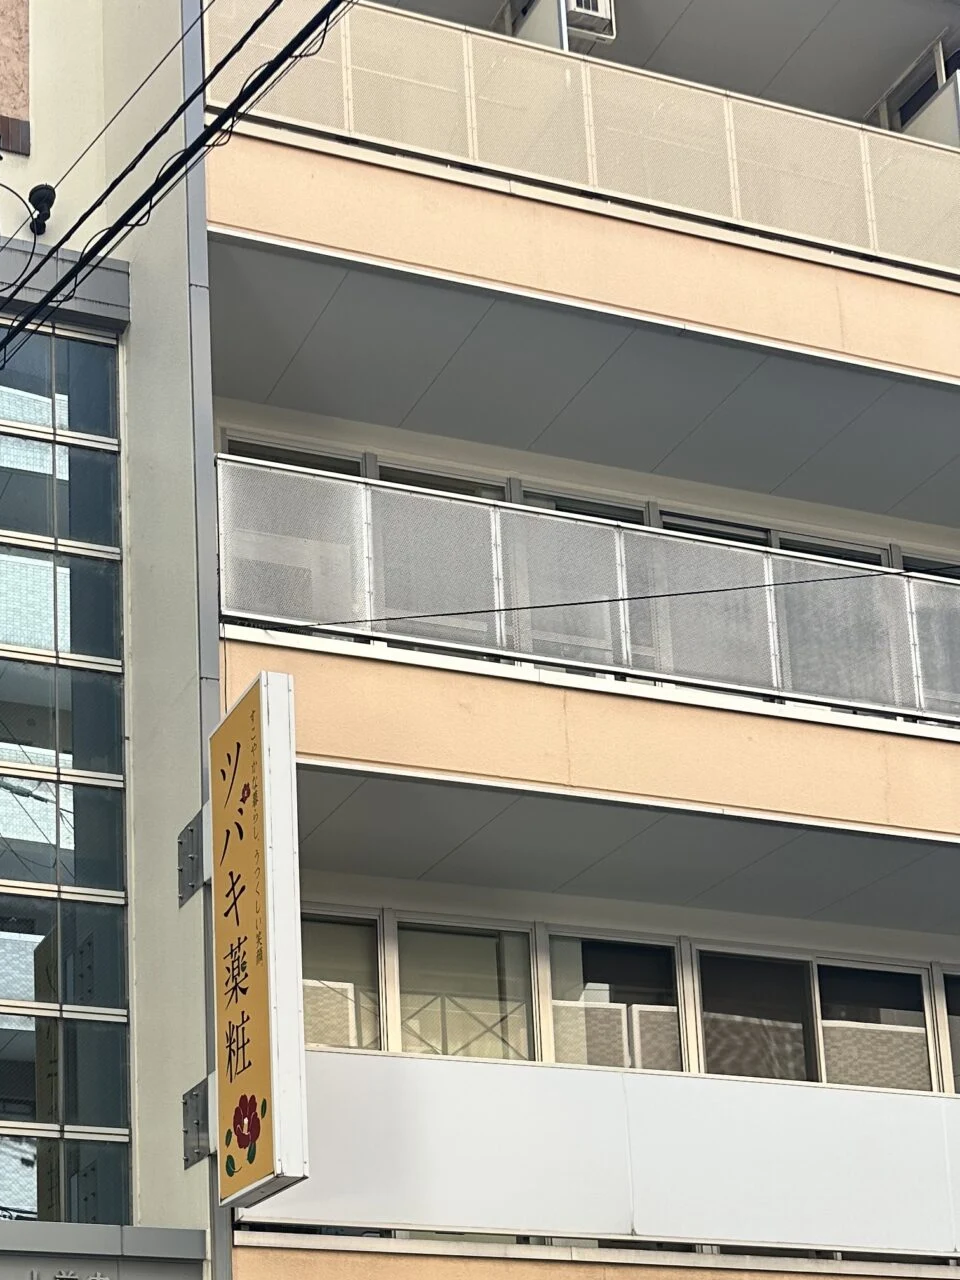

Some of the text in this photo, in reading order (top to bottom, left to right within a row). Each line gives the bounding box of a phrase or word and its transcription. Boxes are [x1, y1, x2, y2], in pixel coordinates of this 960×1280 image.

[219, 741, 252, 1084] ツバキ薬粧
